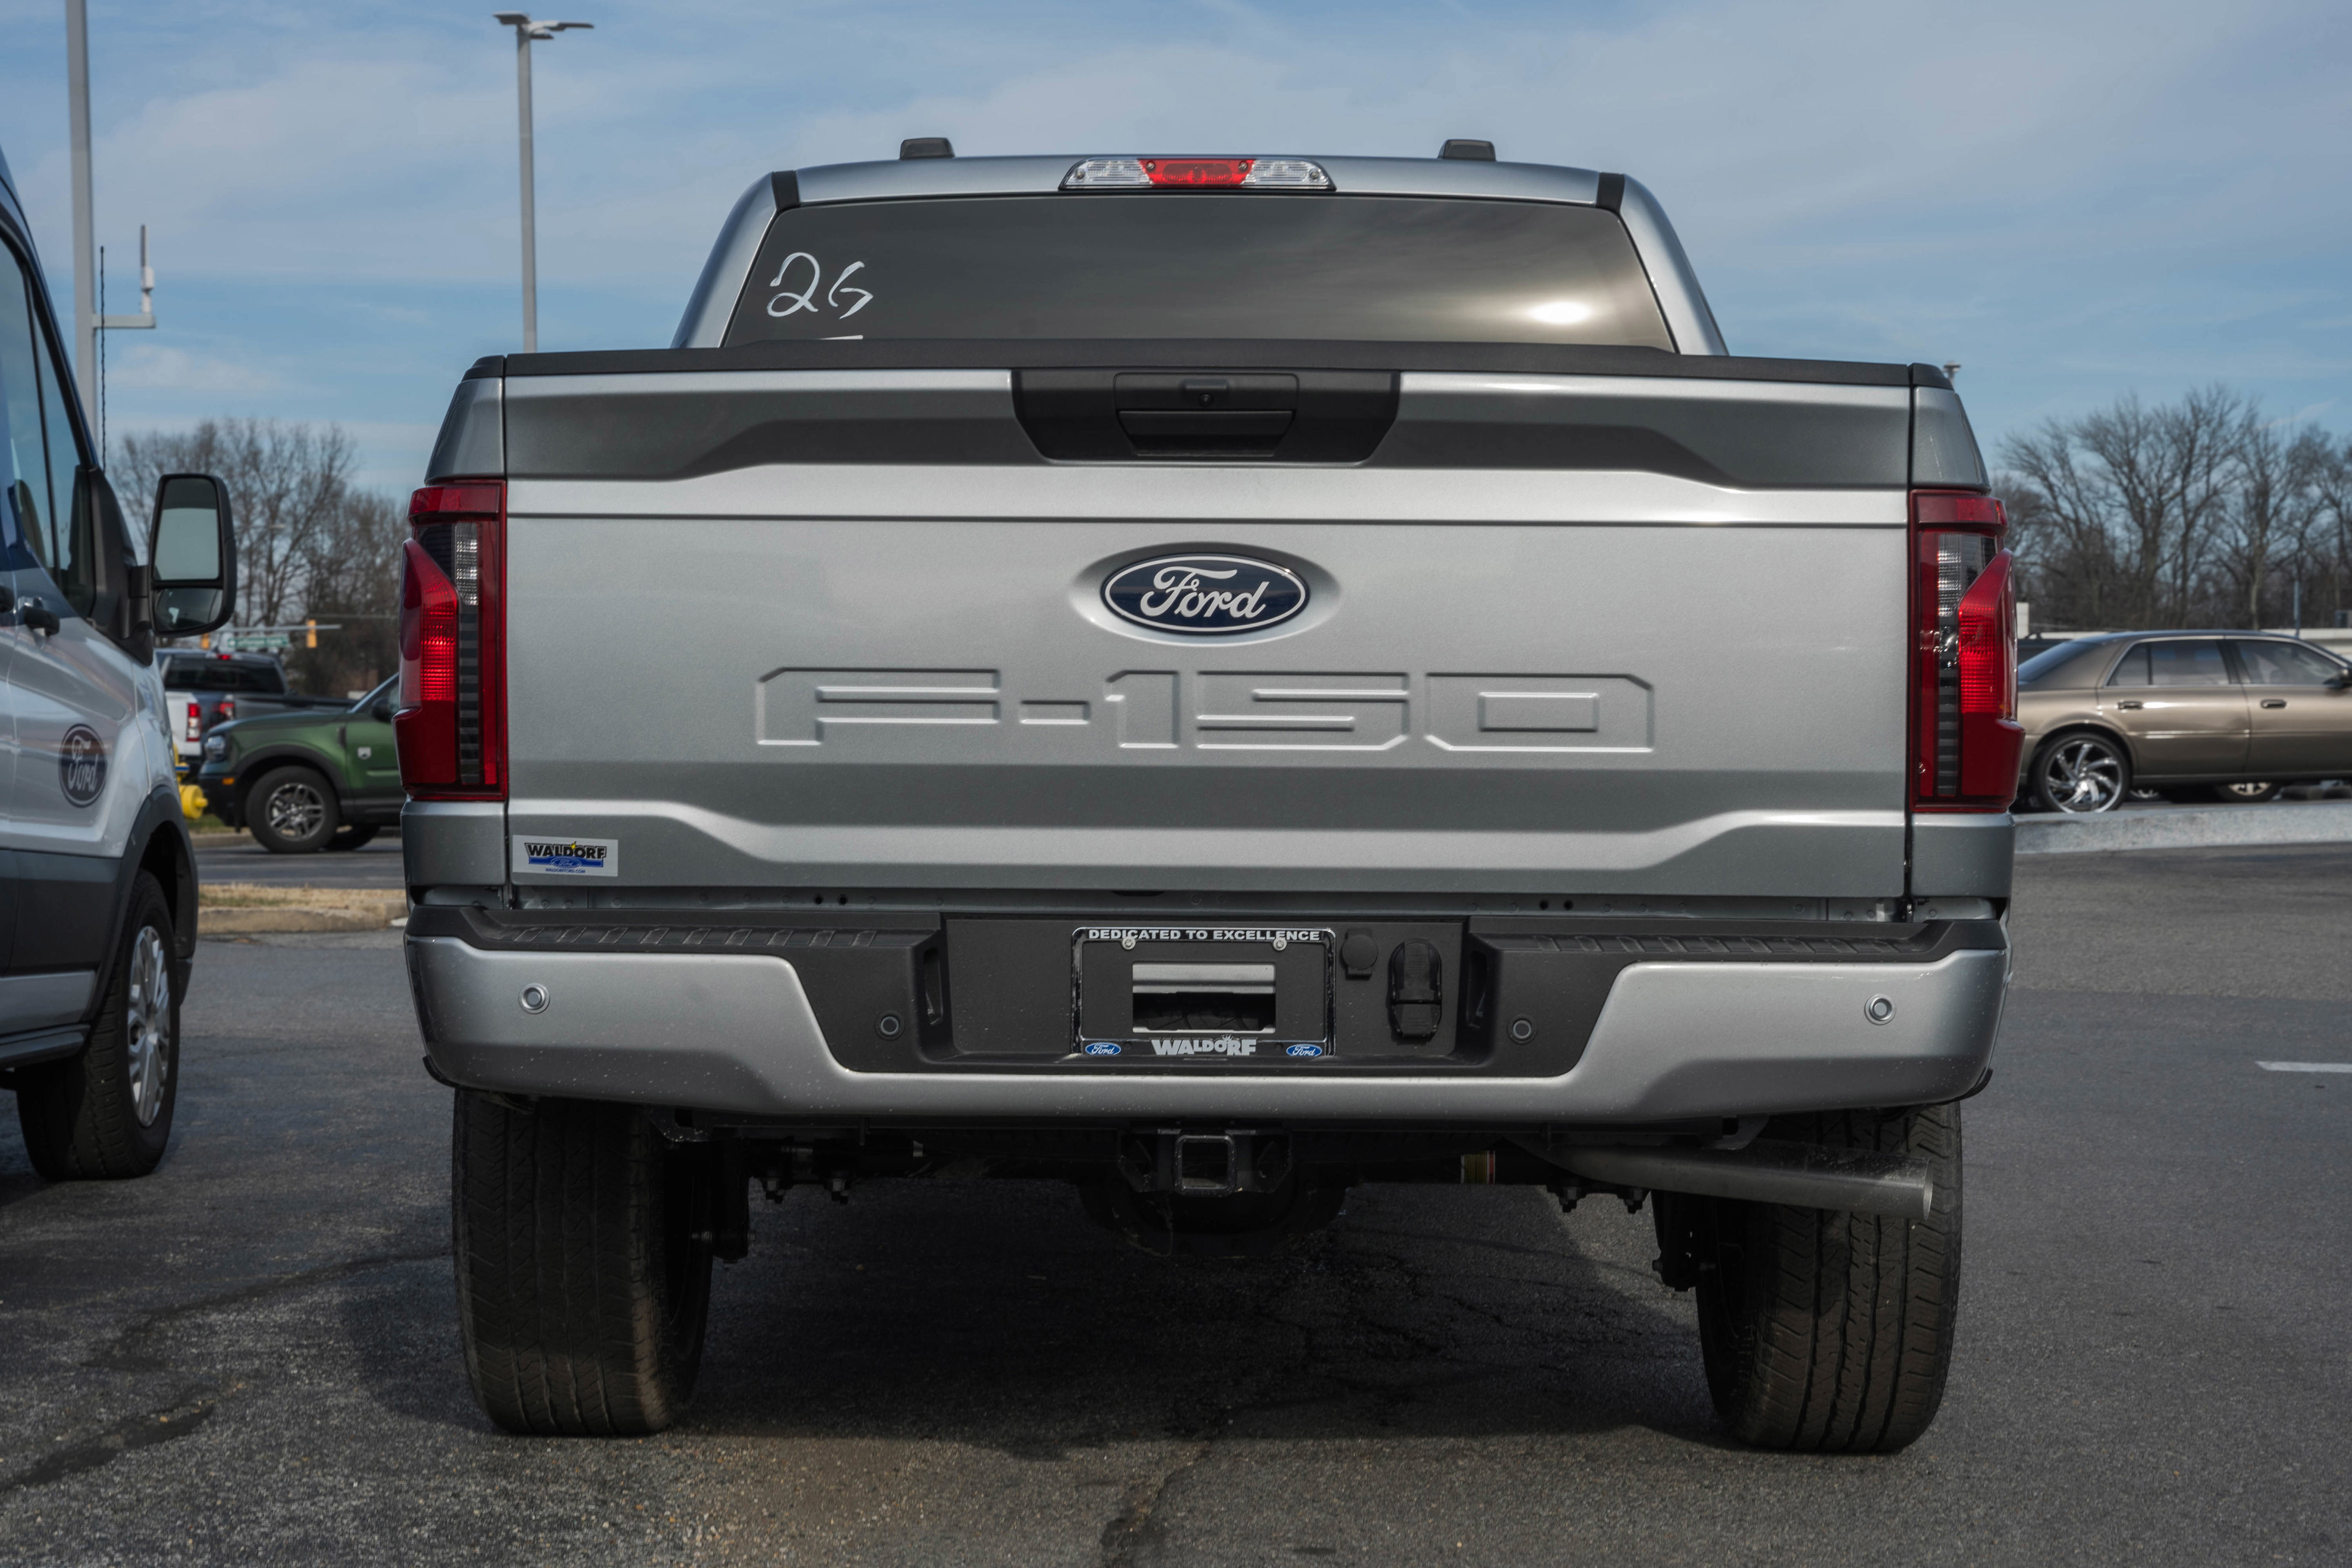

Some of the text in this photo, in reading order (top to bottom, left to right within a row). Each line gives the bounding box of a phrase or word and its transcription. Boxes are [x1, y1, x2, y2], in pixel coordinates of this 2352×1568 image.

[1140, 566, 1270, 619] Ford
[755, 666, 1656, 753] F-150
[68, 735, 99, 792] Ford
[525, 842, 607, 859] WALDORF
[1089, 929, 1320, 941] DEDICATED TO EXCELLENCE
[1091, 1044, 1114, 1054] Ford
[1151, 1038, 1256, 1056] WALDORF
[1292, 1046, 1316, 1056] Ford
